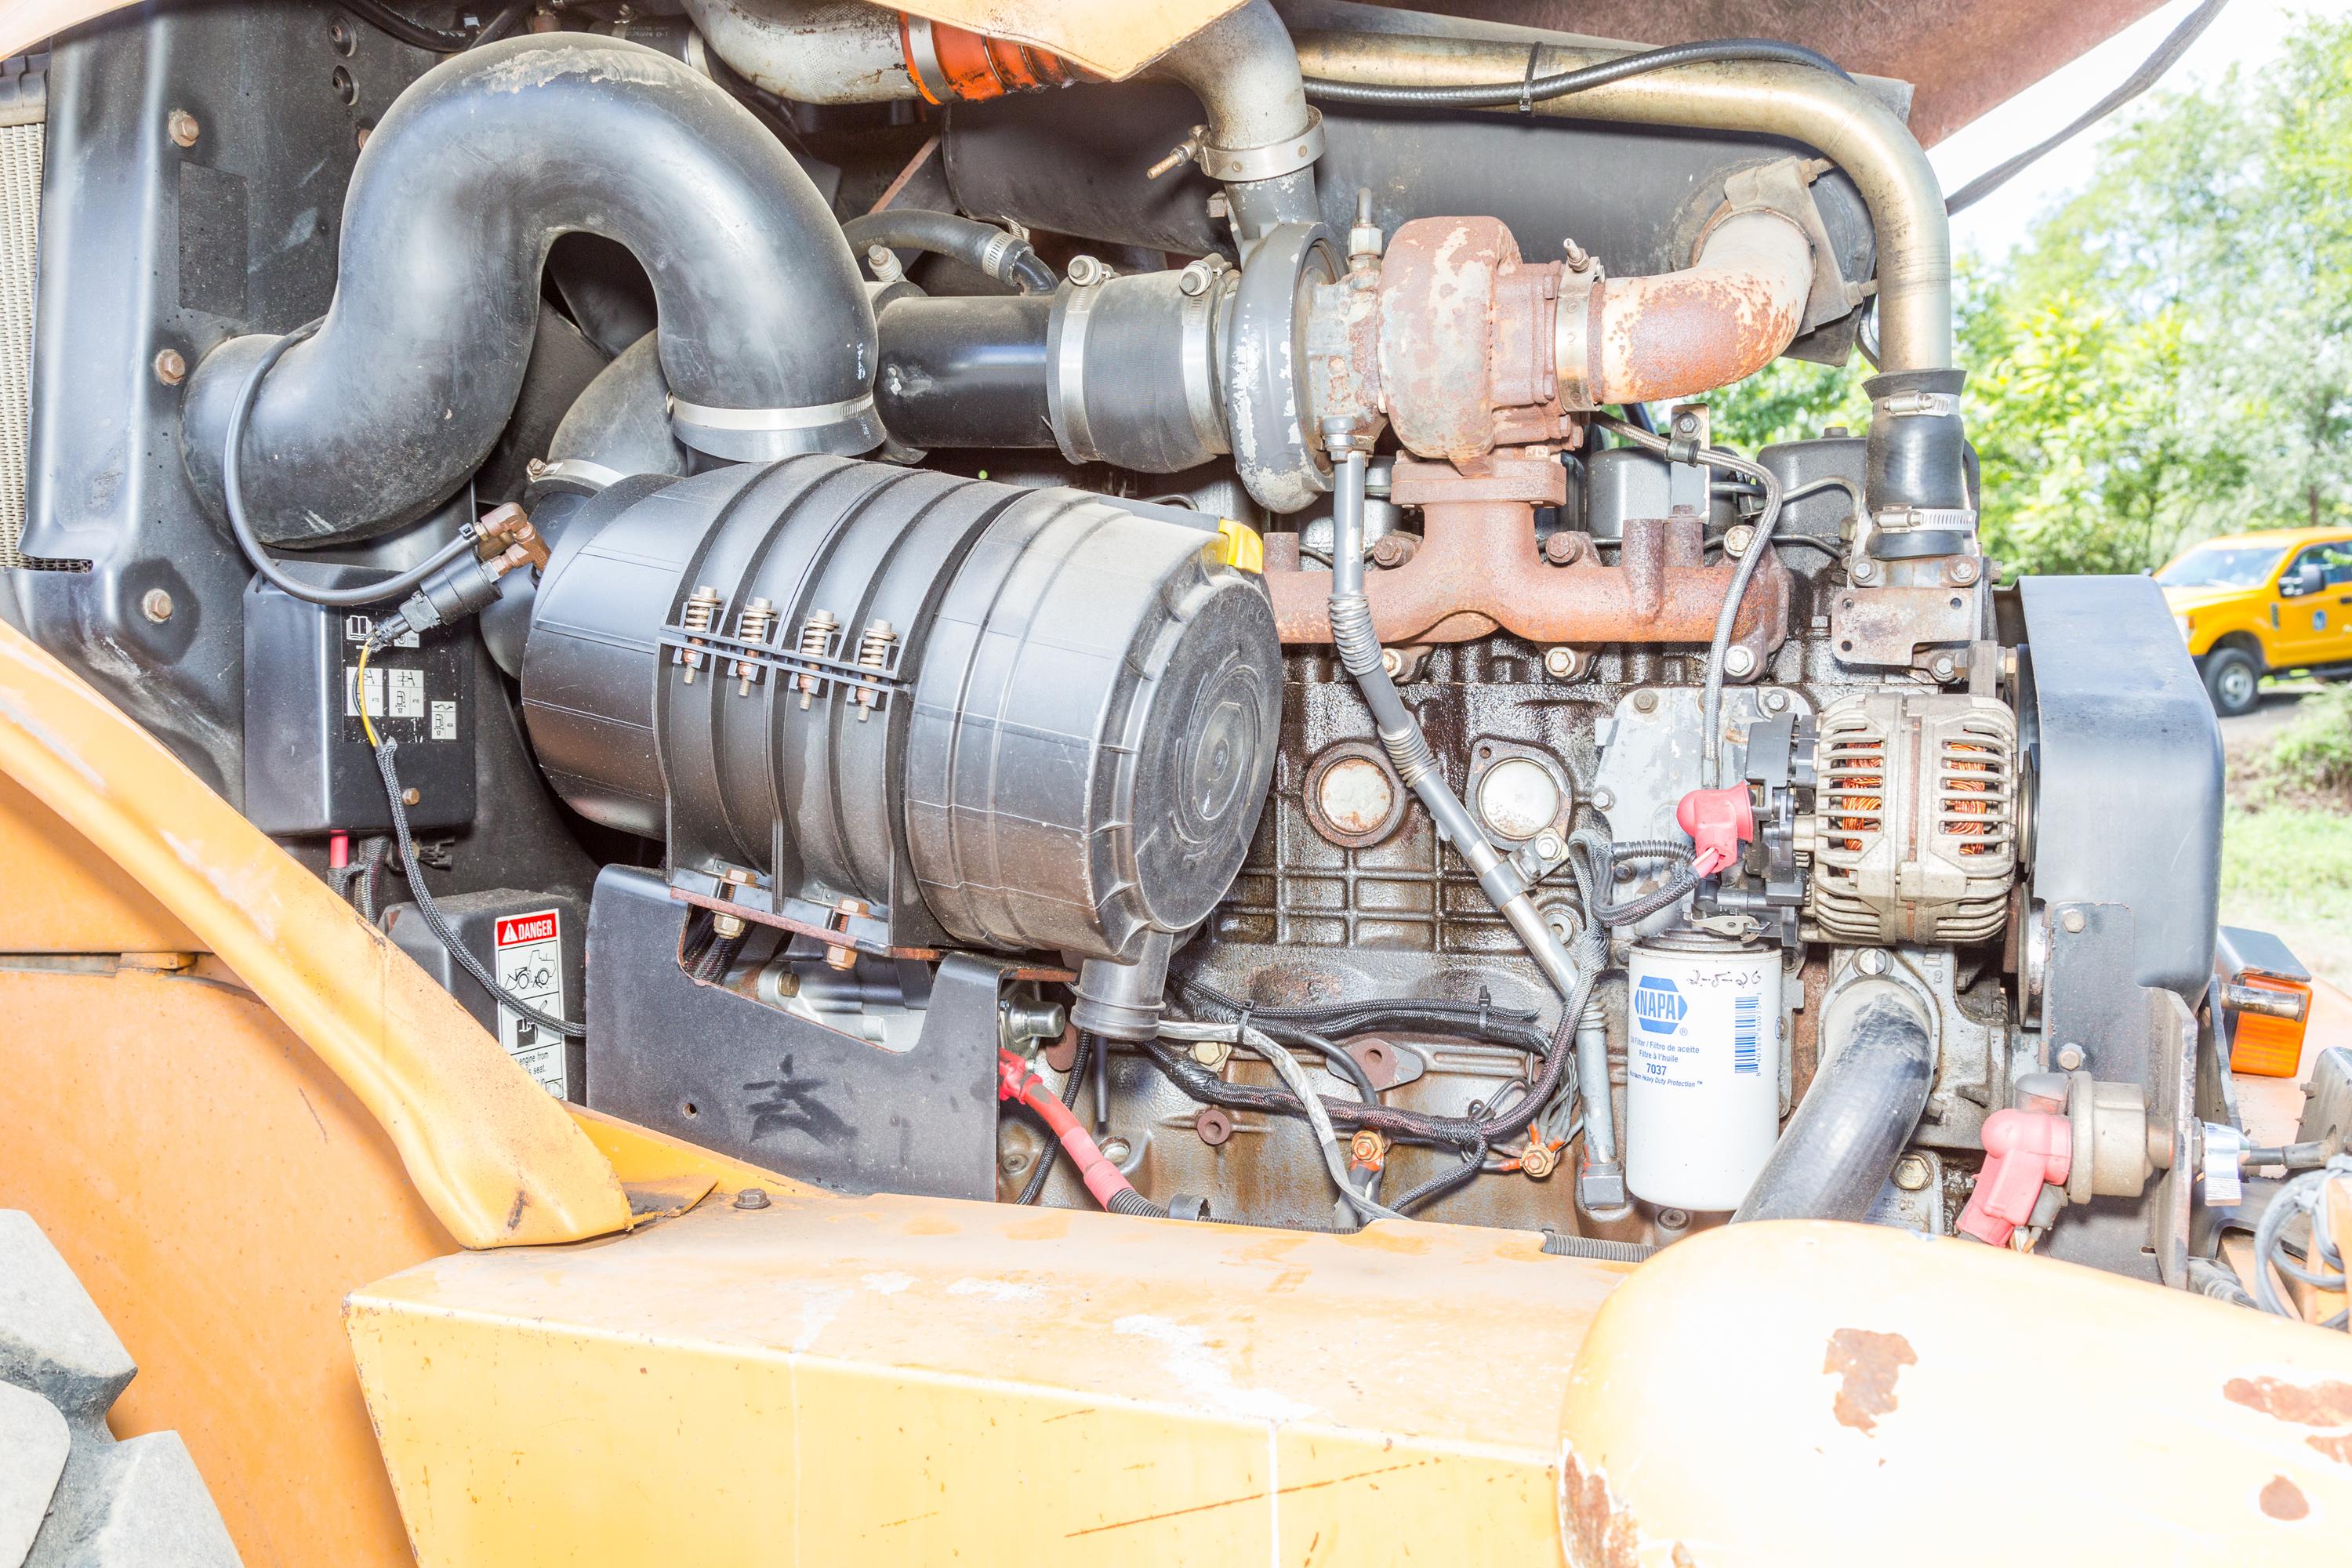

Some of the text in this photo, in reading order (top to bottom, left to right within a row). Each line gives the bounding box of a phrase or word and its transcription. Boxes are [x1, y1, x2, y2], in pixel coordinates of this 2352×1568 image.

[517, 920, 553, 941] DANGER
[1639, 992, 1676, 1021] NAPA
[1635, 1036, 1646, 1047] Filter
[1650, 1040, 1666, 1051] Filtro
[1667, 1044, 1675, 1052] de
[1677, 1045, 1700, 1054] aceite
[519, 1055, 535, 1066] engine
[537, 1051, 549, 1061] from
[1639, 1049, 1652, 1059] Filtre
[1646, 1062, 1668, 1076] 7037
[1642, 1075, 1654, 1084] Heavy
[1654, 1077, 1667, 1086] Duty
[1667, 1079, 1696, 1088] Protection
